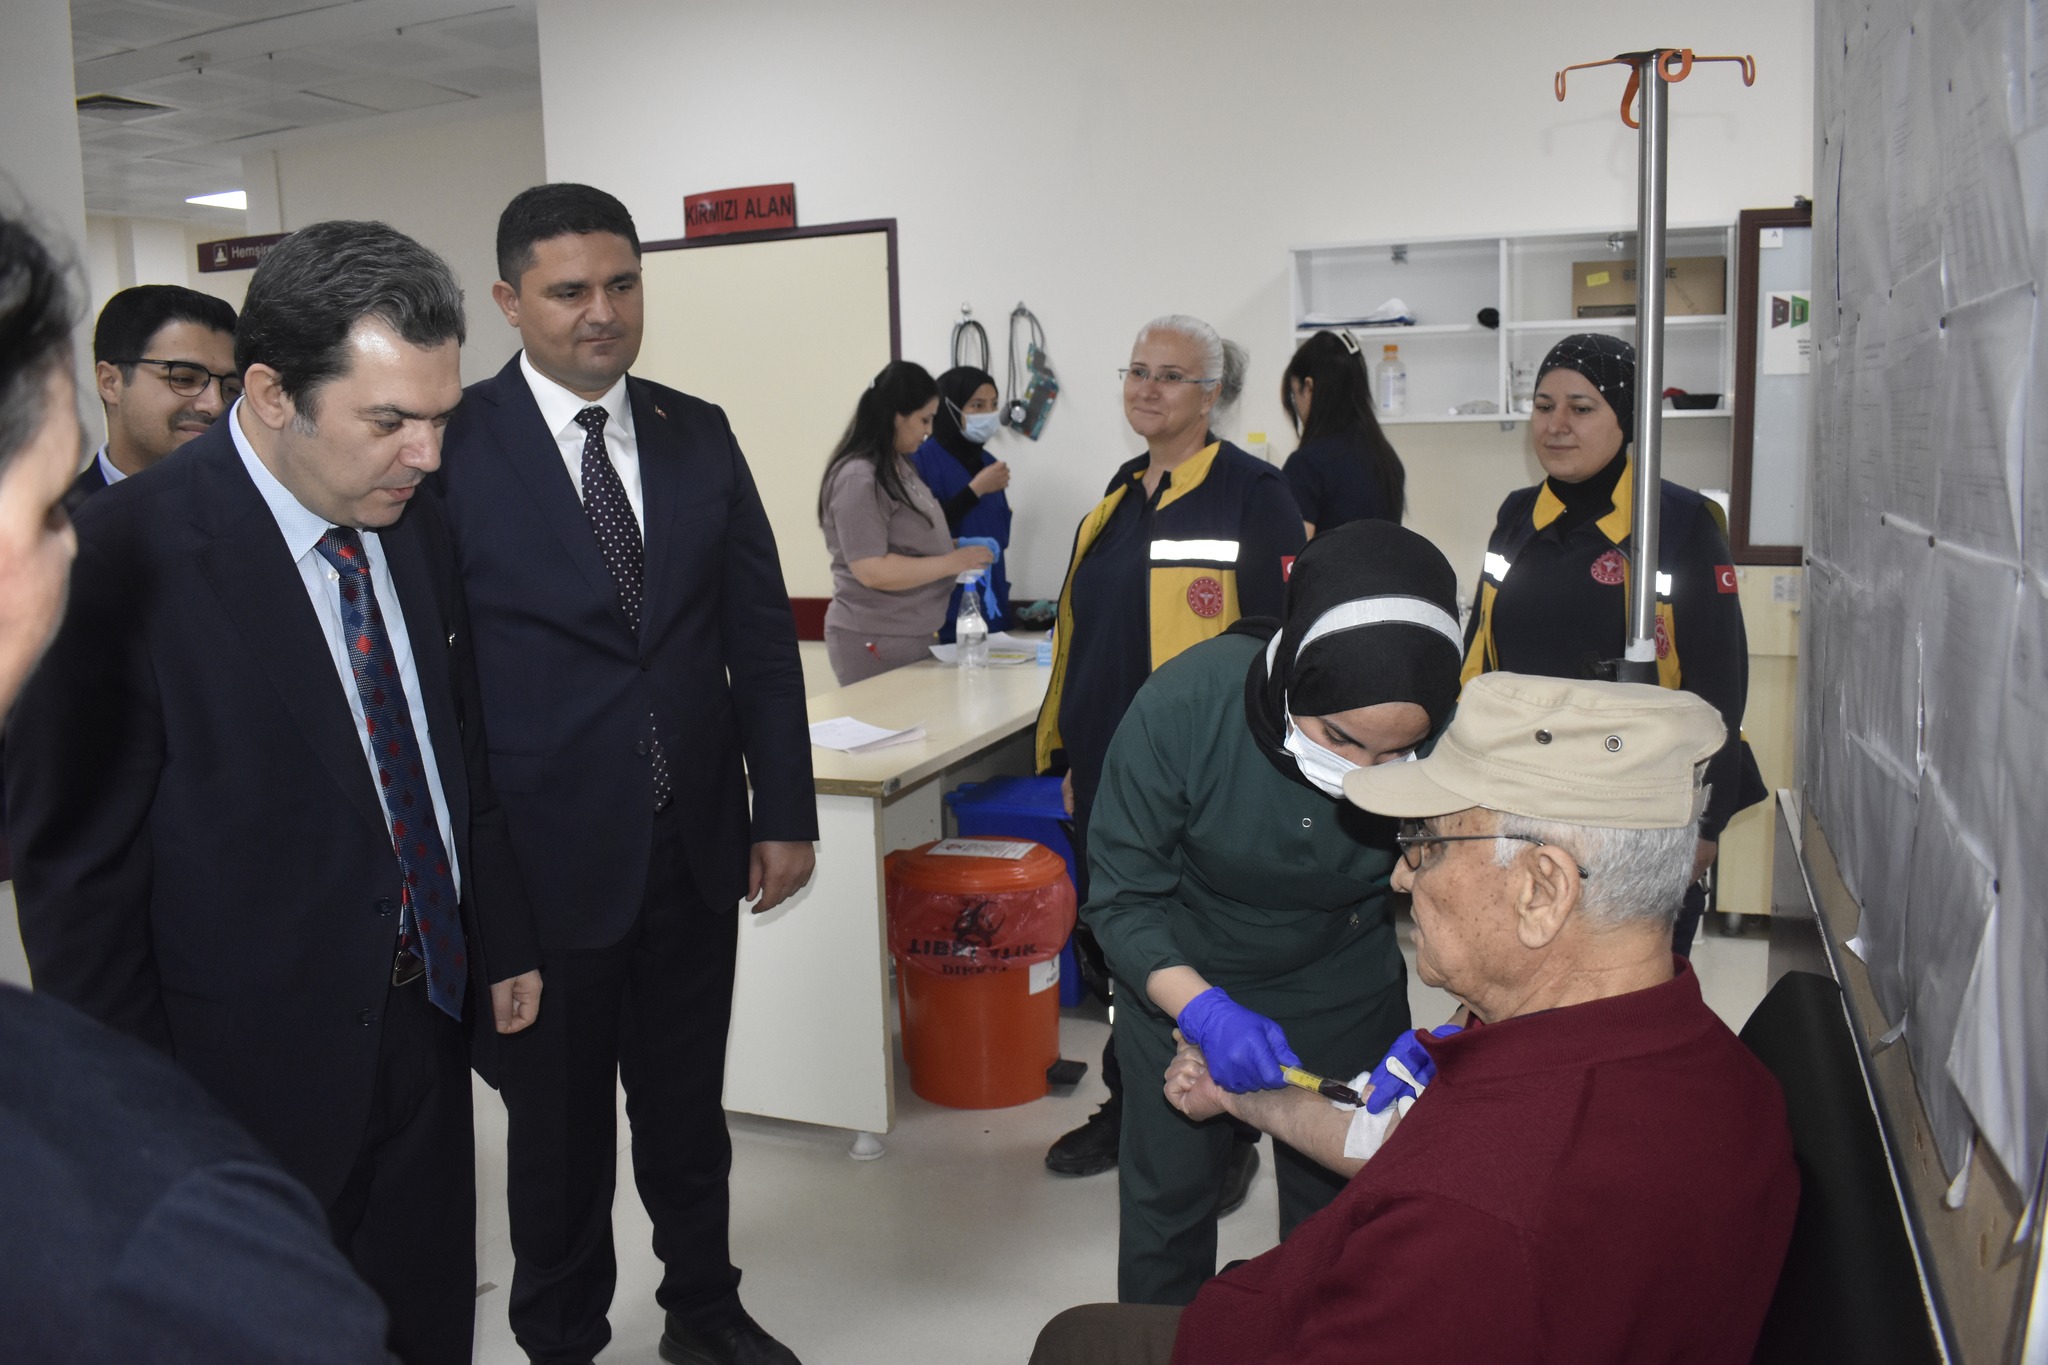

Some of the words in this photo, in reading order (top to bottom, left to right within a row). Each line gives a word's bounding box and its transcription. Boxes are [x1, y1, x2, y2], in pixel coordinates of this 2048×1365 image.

[685, 199, 739, 227] KIRMIZI
[744, 194, 792, 220] ALAN
[231, 243, 272, 260] Hemşir
